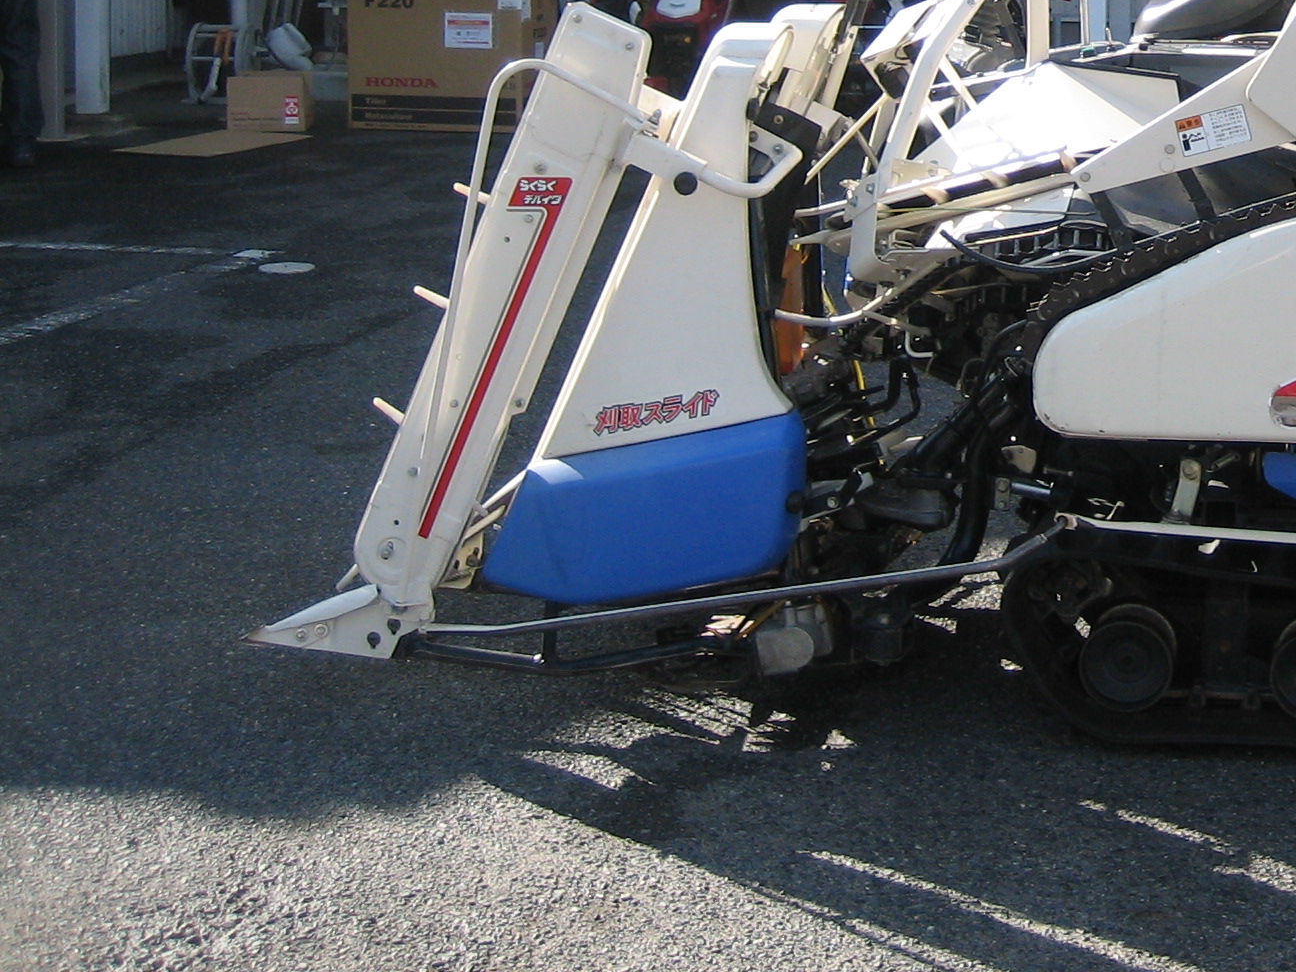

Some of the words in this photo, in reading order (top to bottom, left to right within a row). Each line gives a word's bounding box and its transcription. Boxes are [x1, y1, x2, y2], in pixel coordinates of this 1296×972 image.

[365, 77, 438, 88] HONDA
[593, 389, 719, 435] 刈取スライド
